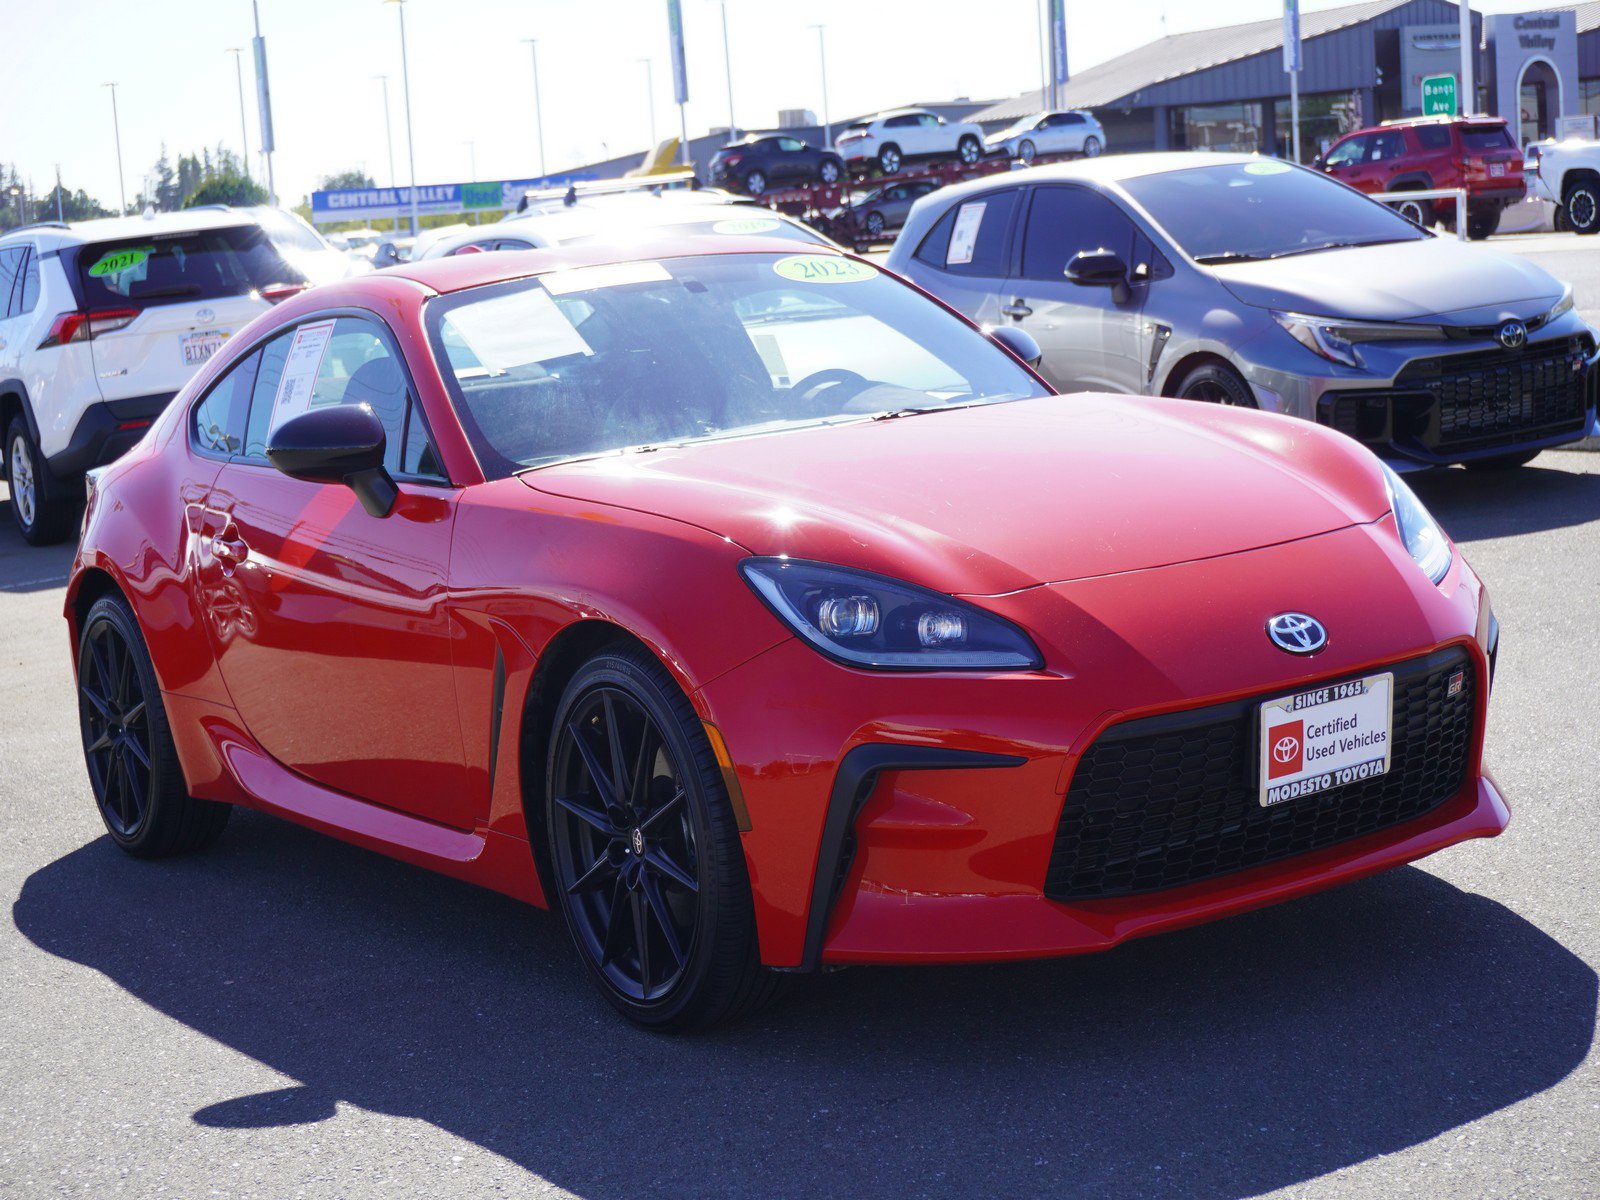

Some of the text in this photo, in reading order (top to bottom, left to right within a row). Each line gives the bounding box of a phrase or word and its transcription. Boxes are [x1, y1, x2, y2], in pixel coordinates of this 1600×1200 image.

[1424, 83, 1454, 97] Bangs
[1432, 100, 1450, 112] Ave
[328, 189, 398, 209] CENTRAL
[399, 186, 455, 204] VALLEY
[465, 187, 499, 204] Used
[101, 254, 135, 275] 2021
[794, 260, 860, 279] 2023
[1295, 681, 1362, 709] SINCE 1965
[1449, 680, 1462, 693] GR
[1306, 713, 1358, 739] Certified
[1306, 729, 1387, 761] Used Vehicles
[1268, 759, 1384, 804] MODESTO TOYOTA
